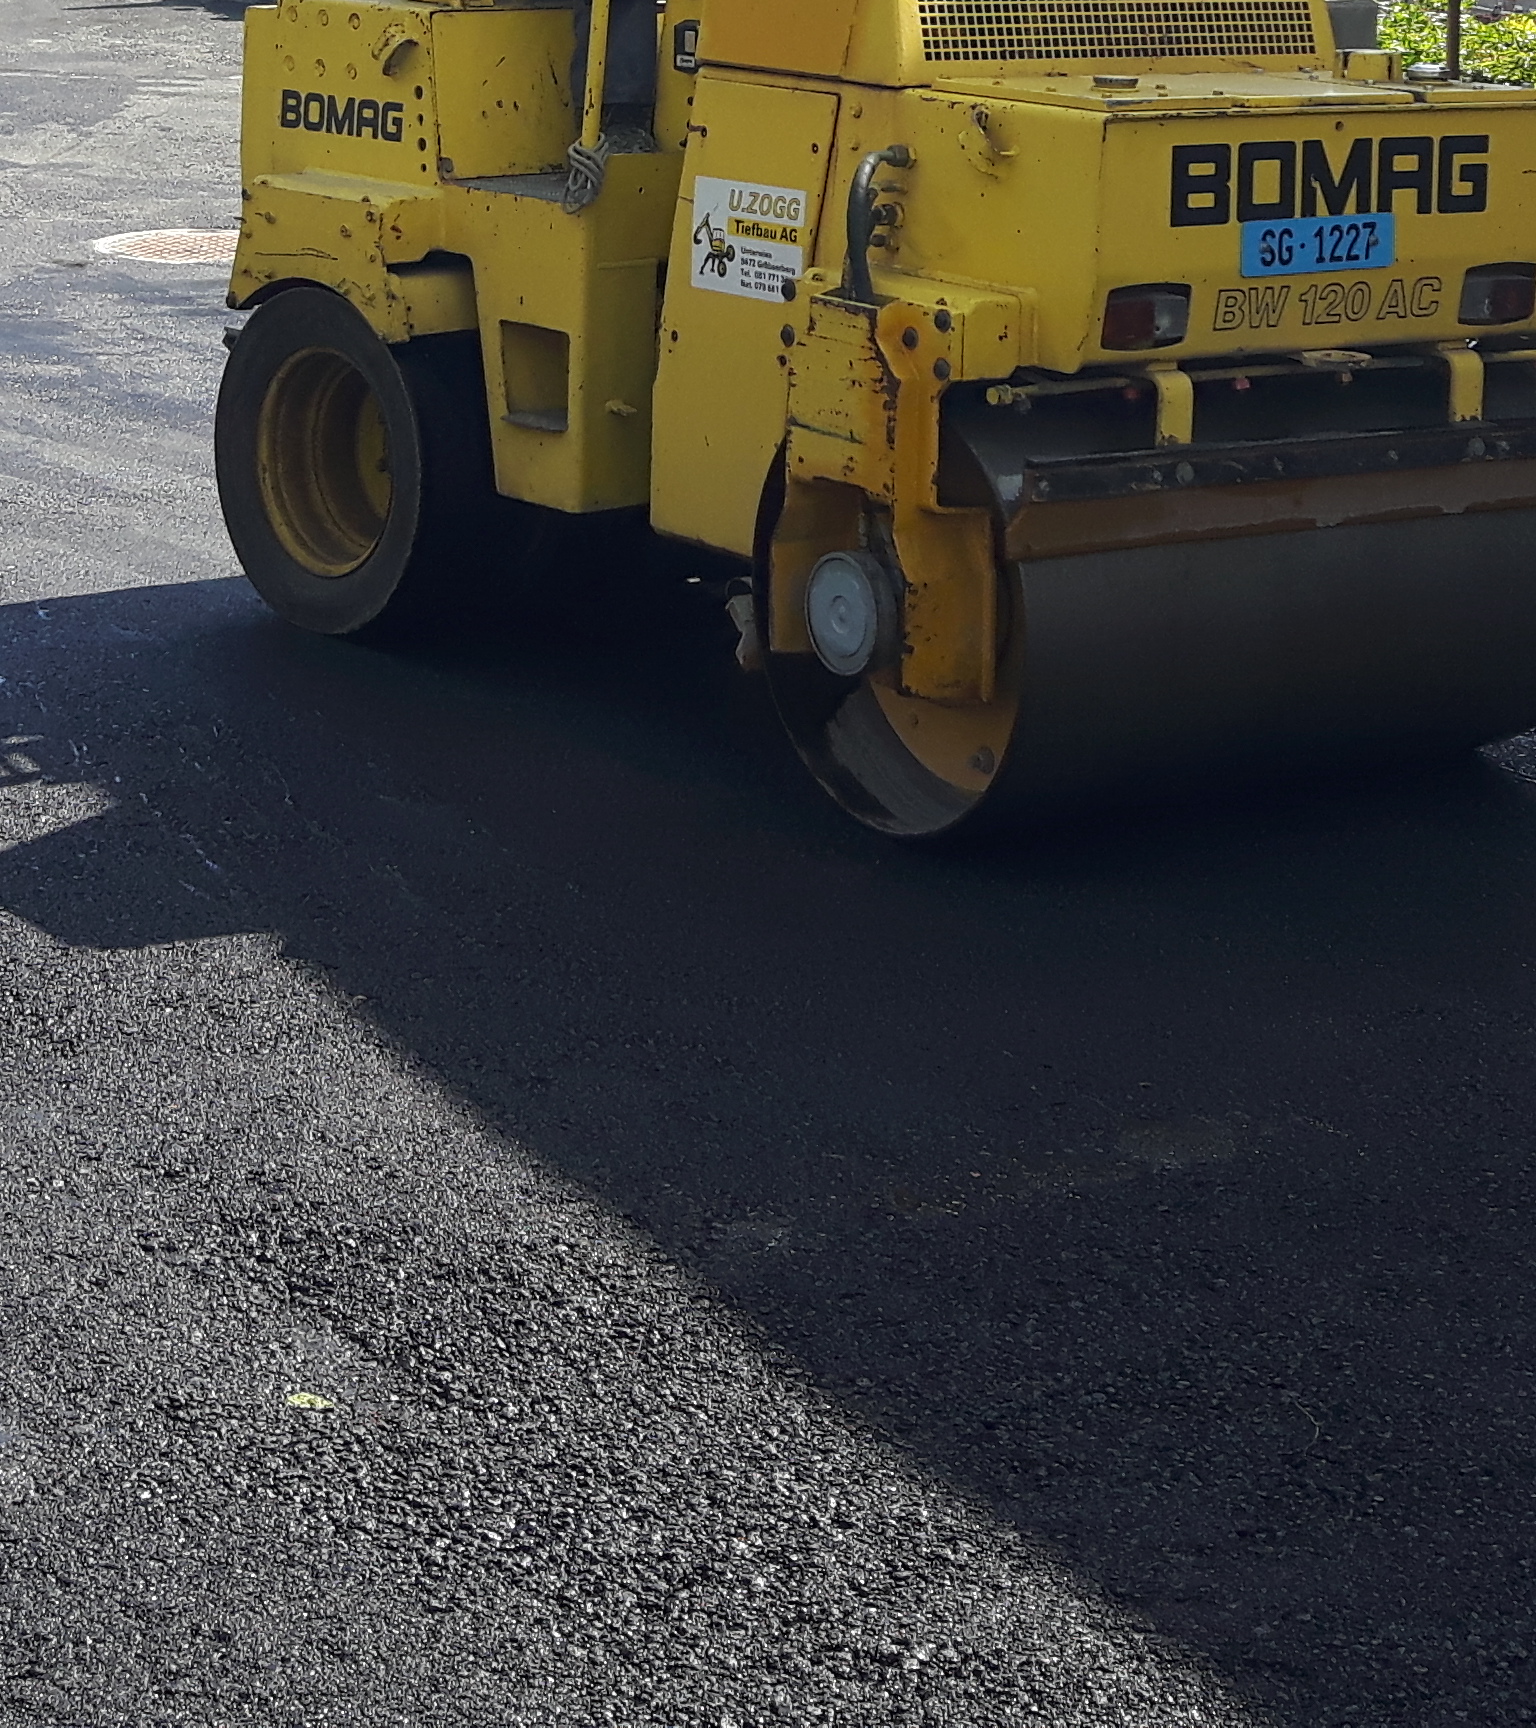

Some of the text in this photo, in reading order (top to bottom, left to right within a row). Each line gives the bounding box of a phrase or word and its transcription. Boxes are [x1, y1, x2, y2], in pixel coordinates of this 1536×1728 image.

[280, 88, 404, 142] BOMAG
[1170, 134, 1490, 227] BOMAG
[734, 219, 798, 243] Tiefbau AG
[1213, 277, 1443, 331] BW 120 AC
